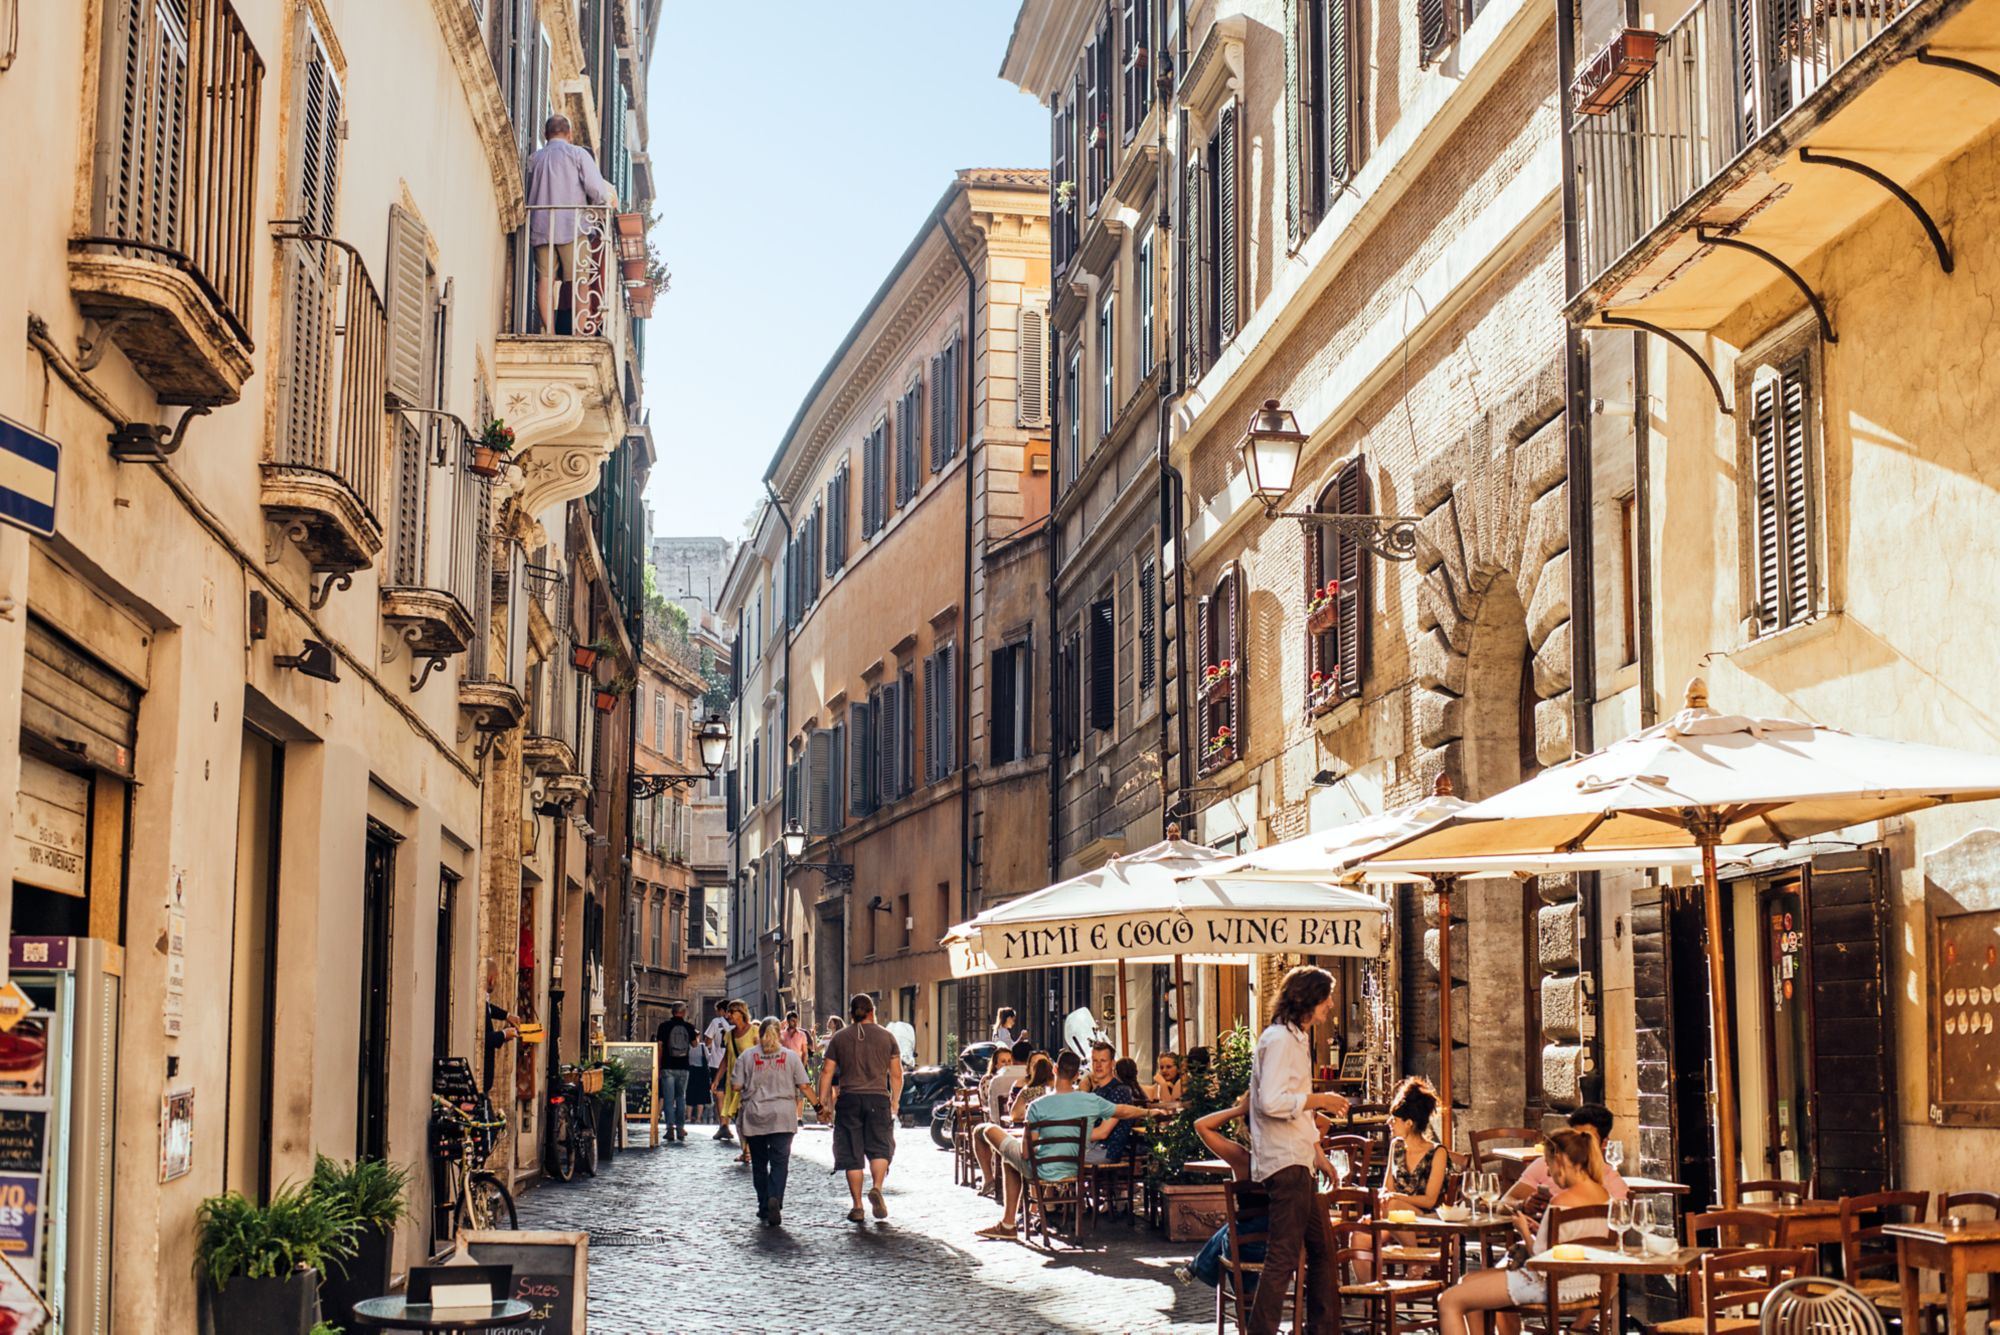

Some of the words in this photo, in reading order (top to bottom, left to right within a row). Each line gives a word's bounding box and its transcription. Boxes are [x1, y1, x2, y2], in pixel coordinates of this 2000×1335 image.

[44, 849, 76, 875] HOMEMADE
[1002, 923, 1080, 960] MIMÌ
[1090, 923, 1108, 951] E
[1117, 911, 1195, 949] COCÒ
[1207, 917, 1289, 945] WINE
[1298, 918, 1364, 950] BAR
[516, 1276, 560, 1299] Sizes
[529, 1302, 554, 1320] est
